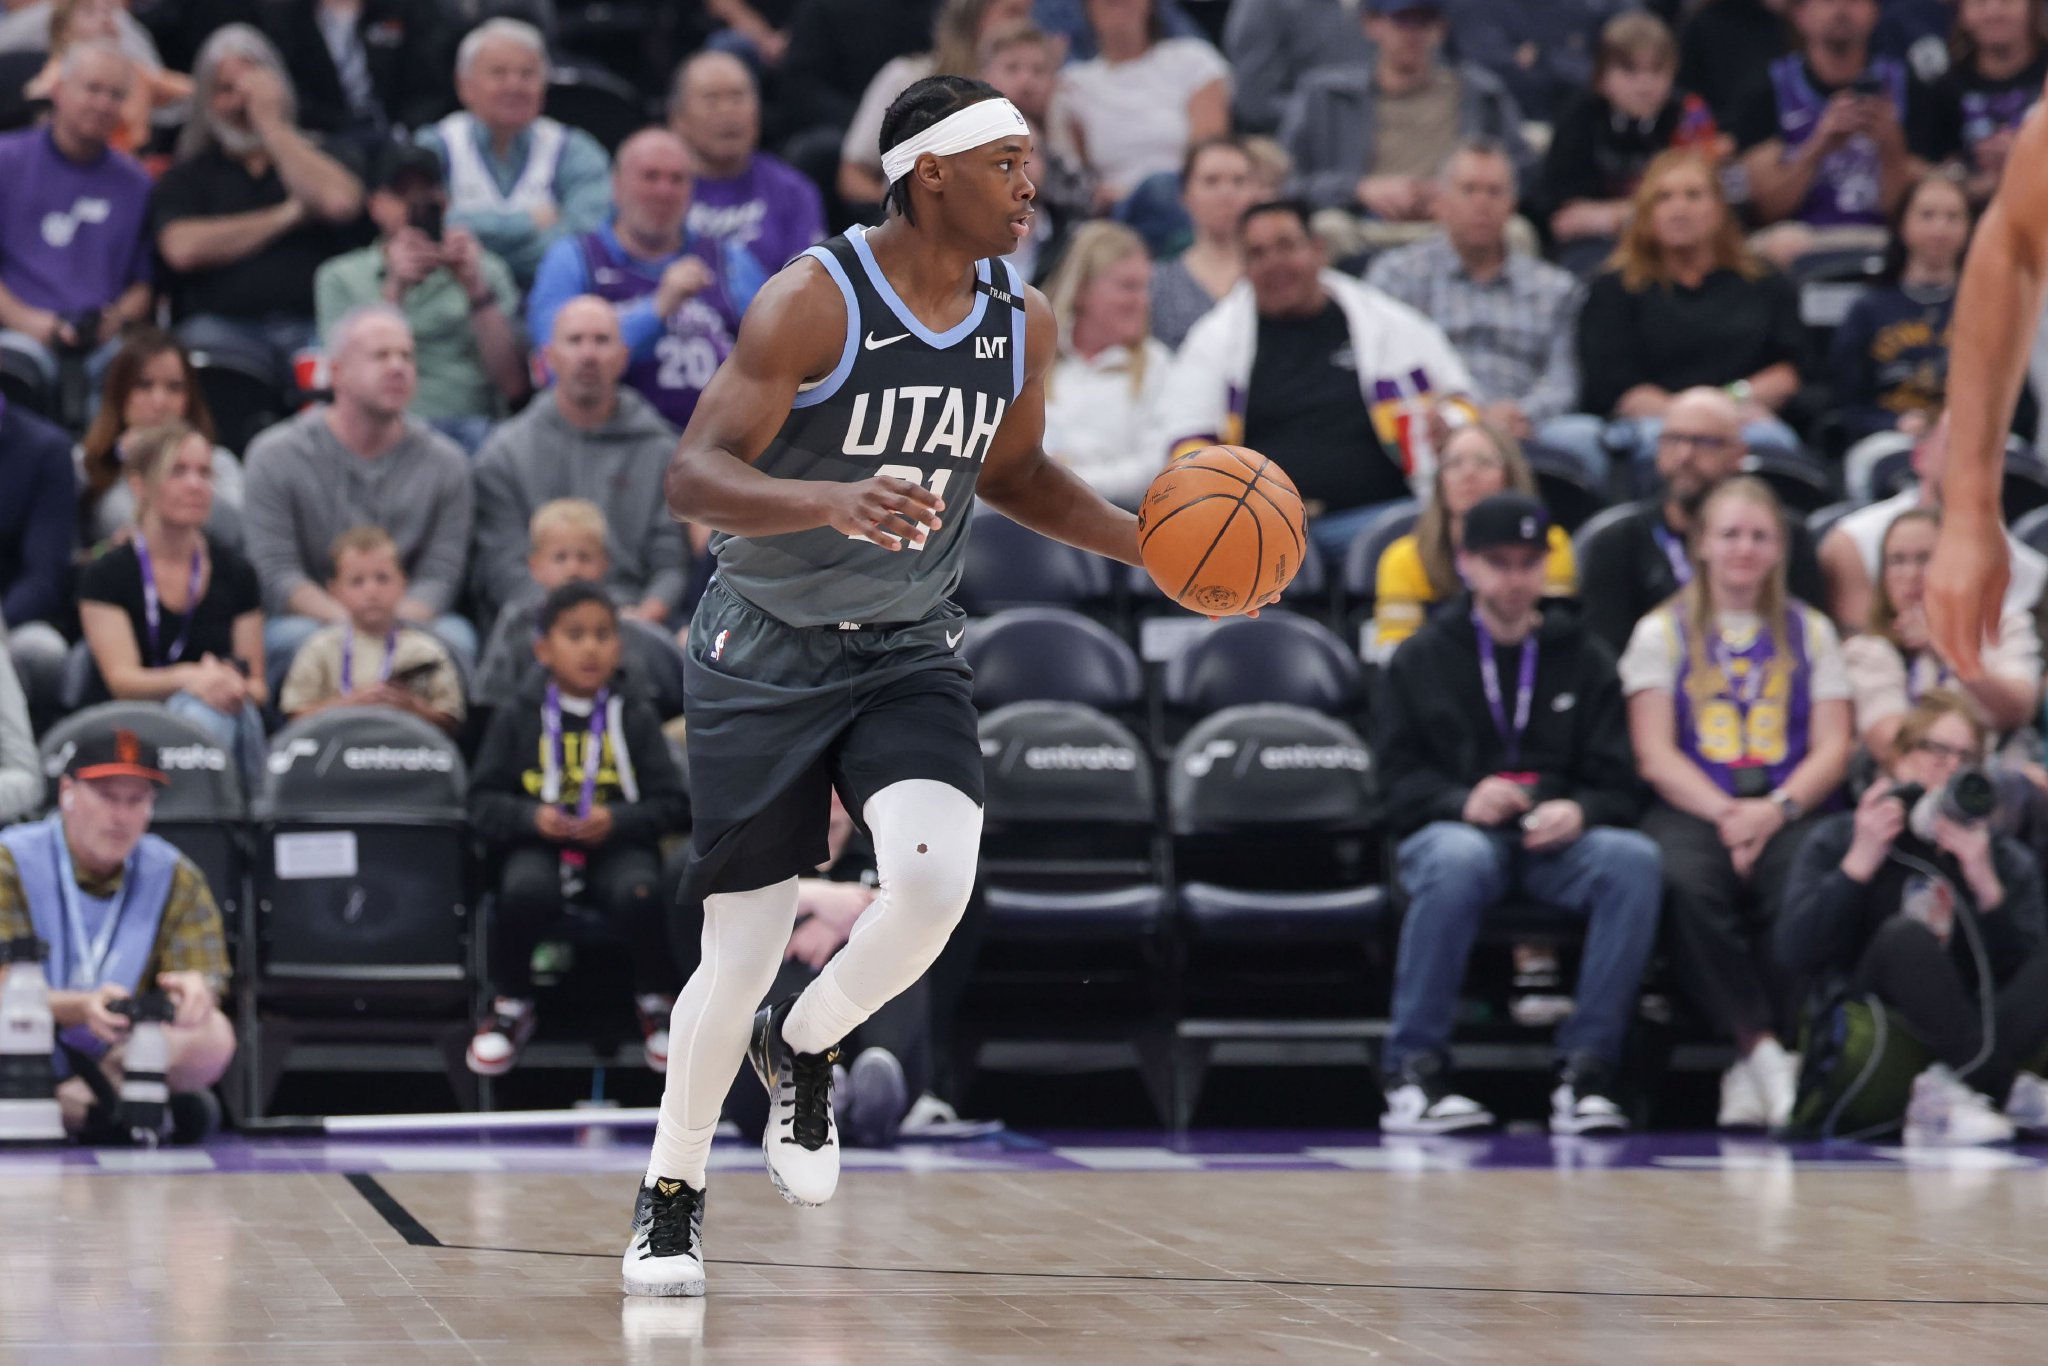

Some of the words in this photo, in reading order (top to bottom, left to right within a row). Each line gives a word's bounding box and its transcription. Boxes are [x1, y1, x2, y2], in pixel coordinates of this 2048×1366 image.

[990, 286, 1011, 303] FRANK
[975, 337, 1008, 358] LVT
[842, 386, 1006, 463] UTAH
